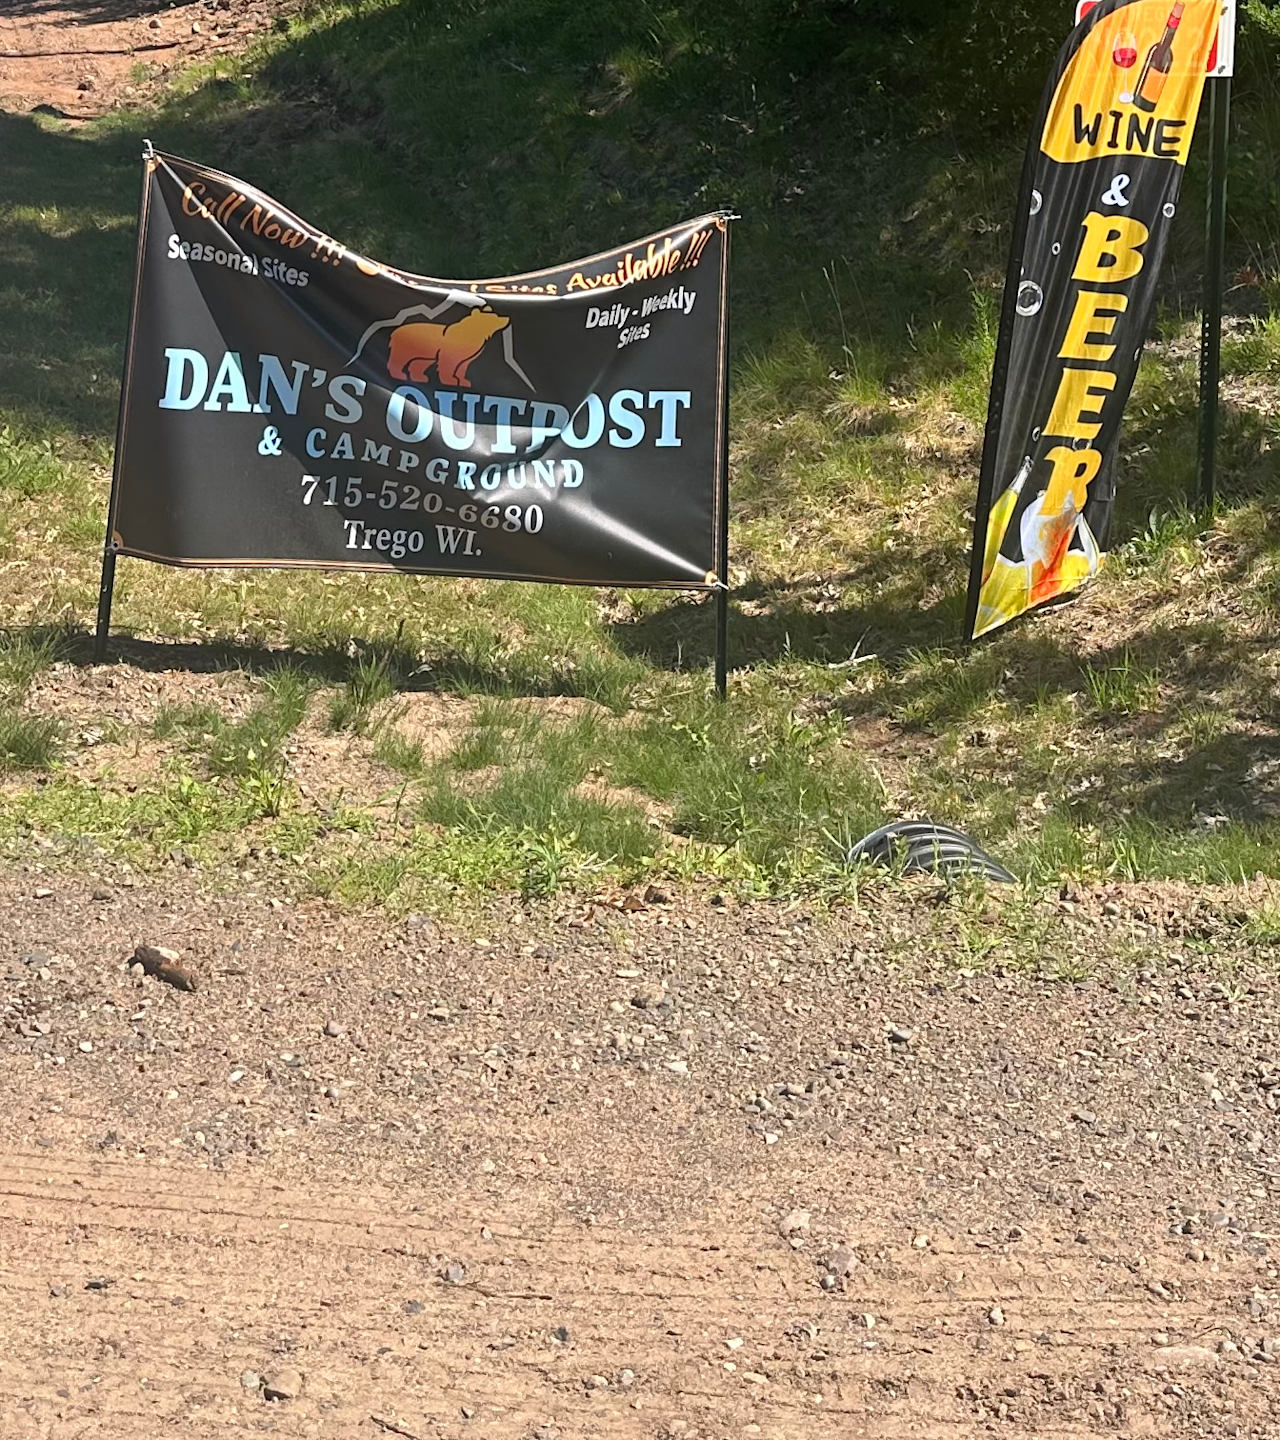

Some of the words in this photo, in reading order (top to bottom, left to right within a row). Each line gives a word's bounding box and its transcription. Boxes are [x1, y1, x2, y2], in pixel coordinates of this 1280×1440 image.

[1074, 103, 1187, 157] WINE
[181, 180, 247, 227] Call
[1101, 173, 1131, 208] &
[167, 233, 260, 276] Seasonal
[261, 255, 310, 288] Sites
[640, 285, 697, 315] Weekly
[616, 322, 651, 349] Sites
[1036, 210, 1150, 517] BEER
[158, 347, 368, 424] DAN'S
[385, 386, 692, 455] OUTPOST
[257, 425, 283, 456] &
[305, 427, 585, 491] CAMPGROUND
[301, 474, 544, 536] 715-520-6680
[344, 519, 424, 559] Trego
[435, 524, 483, 557] WI.
